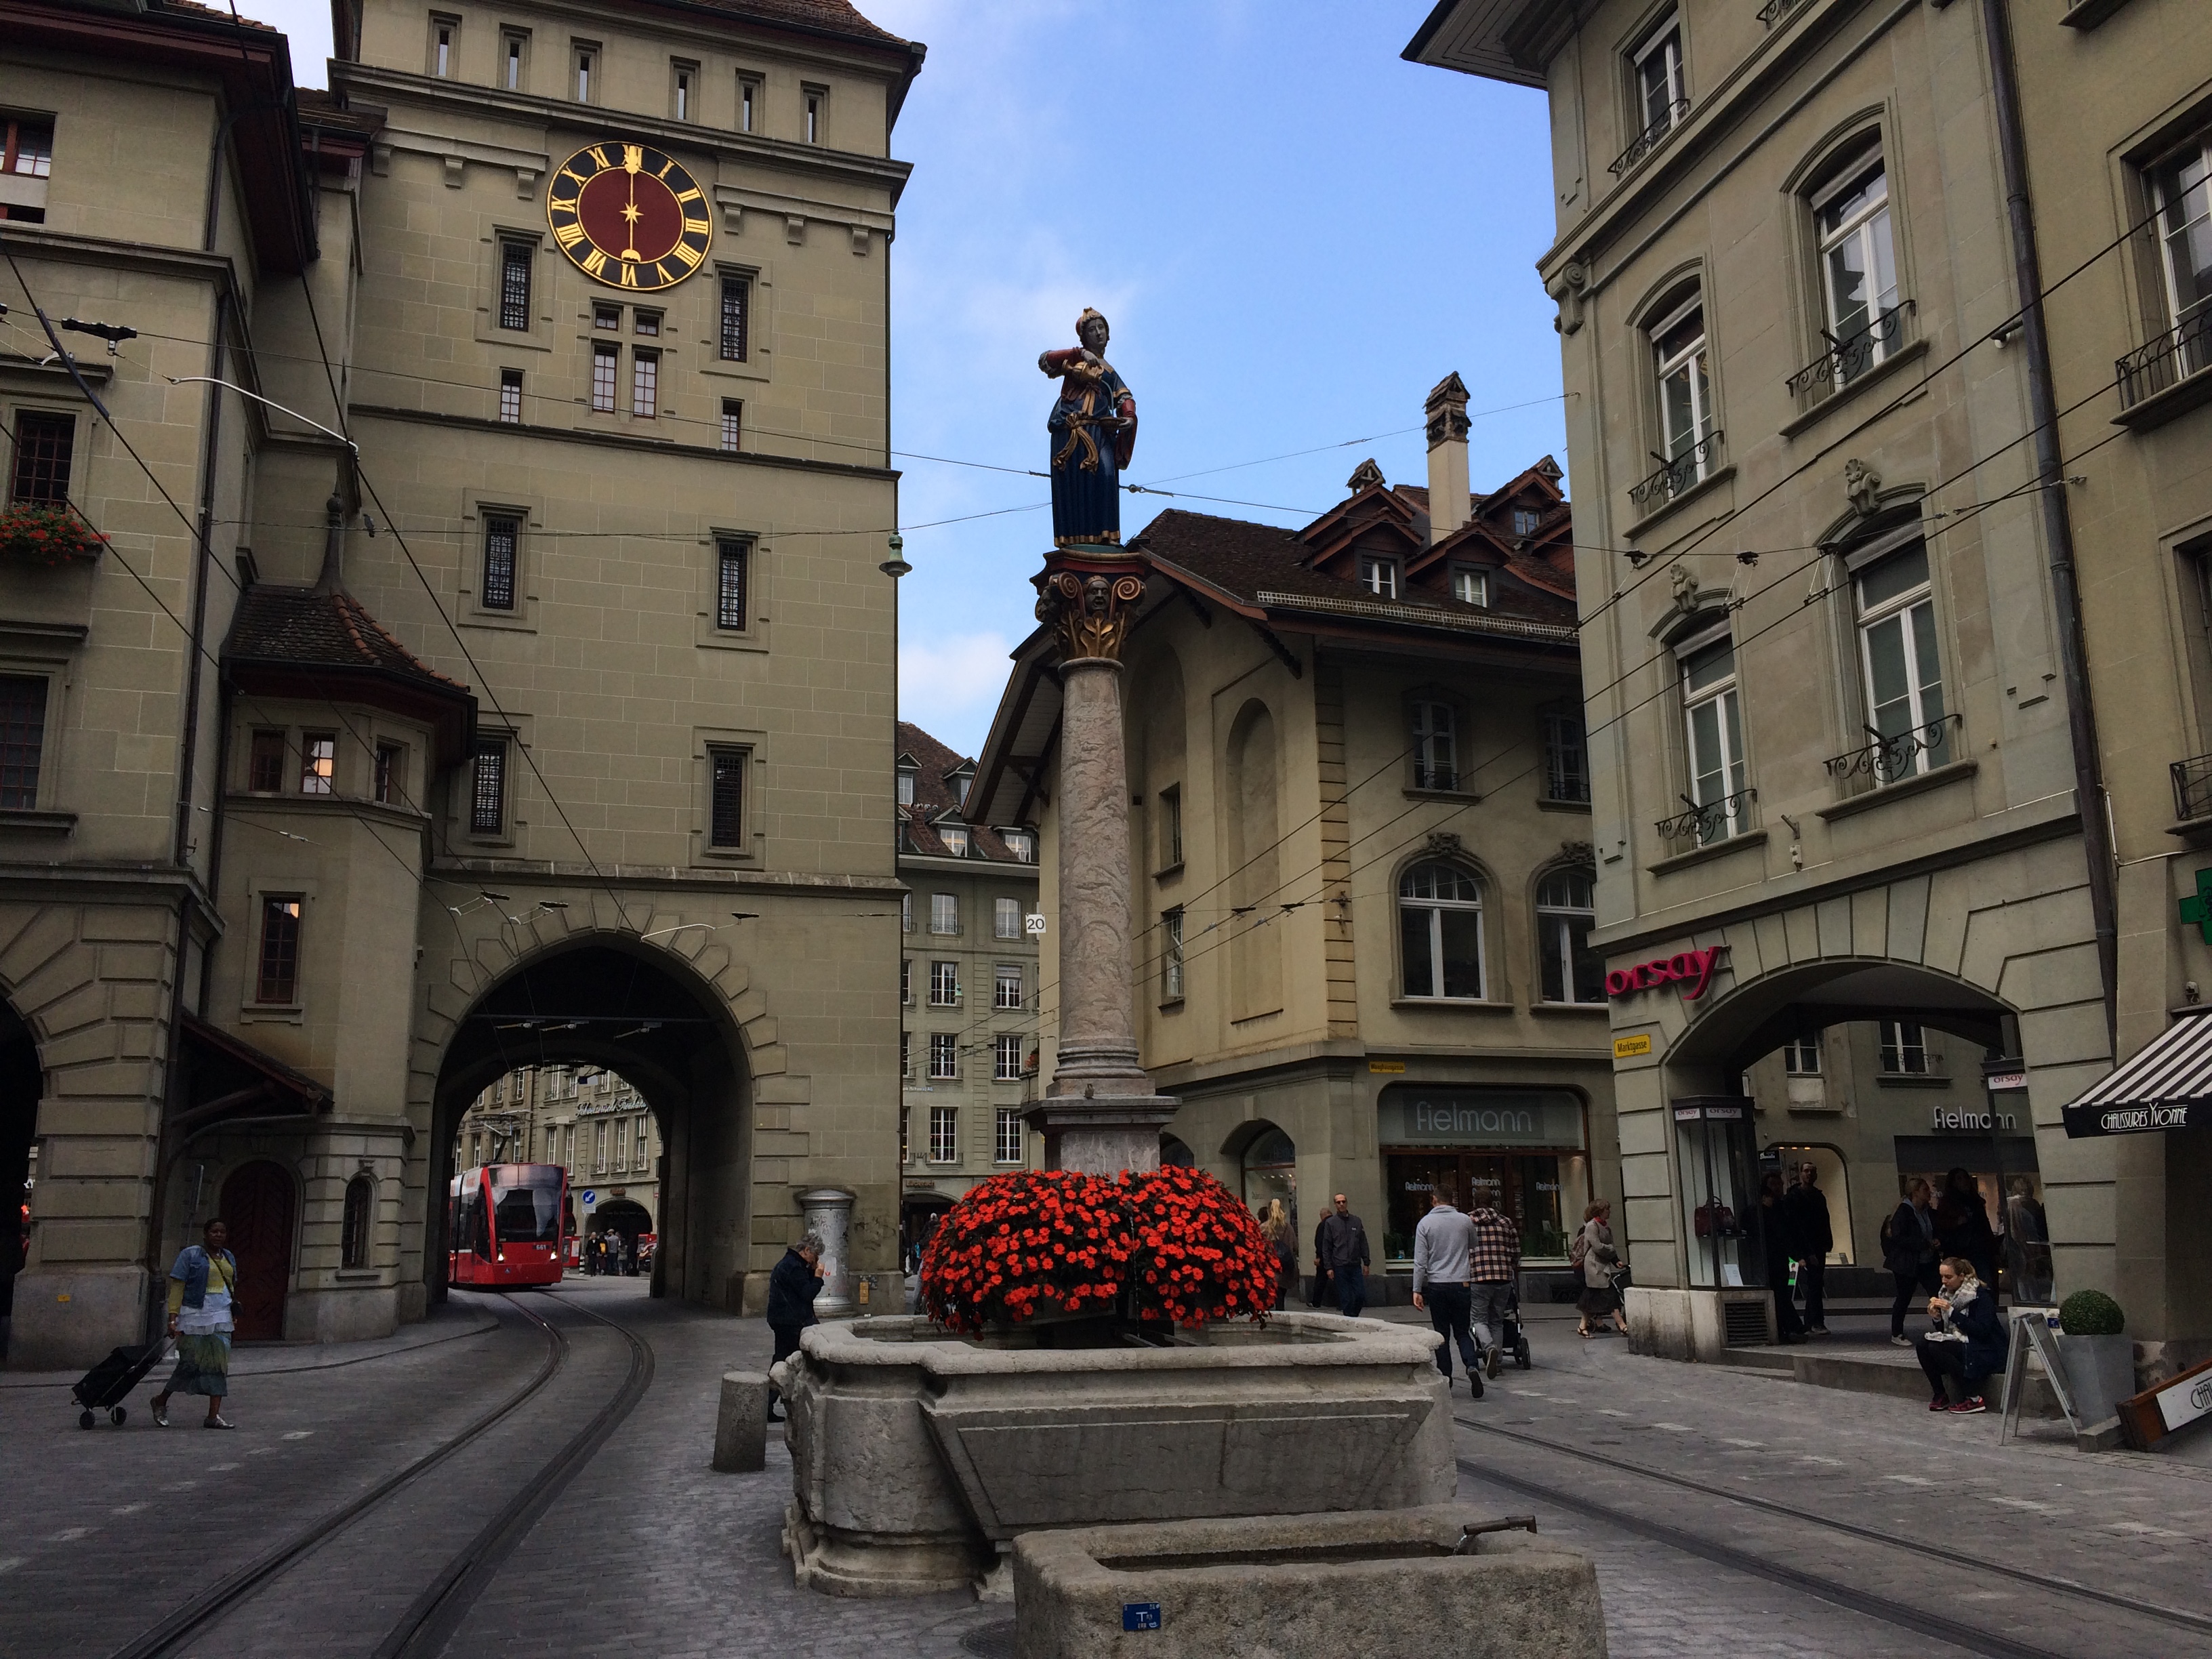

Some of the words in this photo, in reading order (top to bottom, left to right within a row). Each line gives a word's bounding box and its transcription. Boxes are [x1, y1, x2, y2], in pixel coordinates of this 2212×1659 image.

[586, 146, 611, 171] XI
[560, 165, 588, 187] X
[657, 159, 675, 180] I
[551, 194, 576, 213] IX
[676, 187, 701, 203] II
[556, 222, 586, 251] VIII
[685, 217, 709, 236] III
[581, 247, 608, 276] VII
[673, 241, 702, 268] IIII
[620, 263, 638, 287] VI
[656, 262, 675, 285] V
[1027, 918, 1044, 930] 20
[1605, 946, 1723, 1001] orsay
[1617, 1040, 1647, 1053] Marktgasse
[1993, 1074, 2024, 1086] orsay
[1416, 1101, 1532, 1132] fielmann
[1678, 1109, 1697, 1118] orsay
[1709, 1108, 1738, 1118] orsay
[1933, 1105, 2018, 1130] fielmann
[2101, 1111, 2148, 1130] CHAUSSURES
[1471, 1176, 1501, 1187] fielmann
